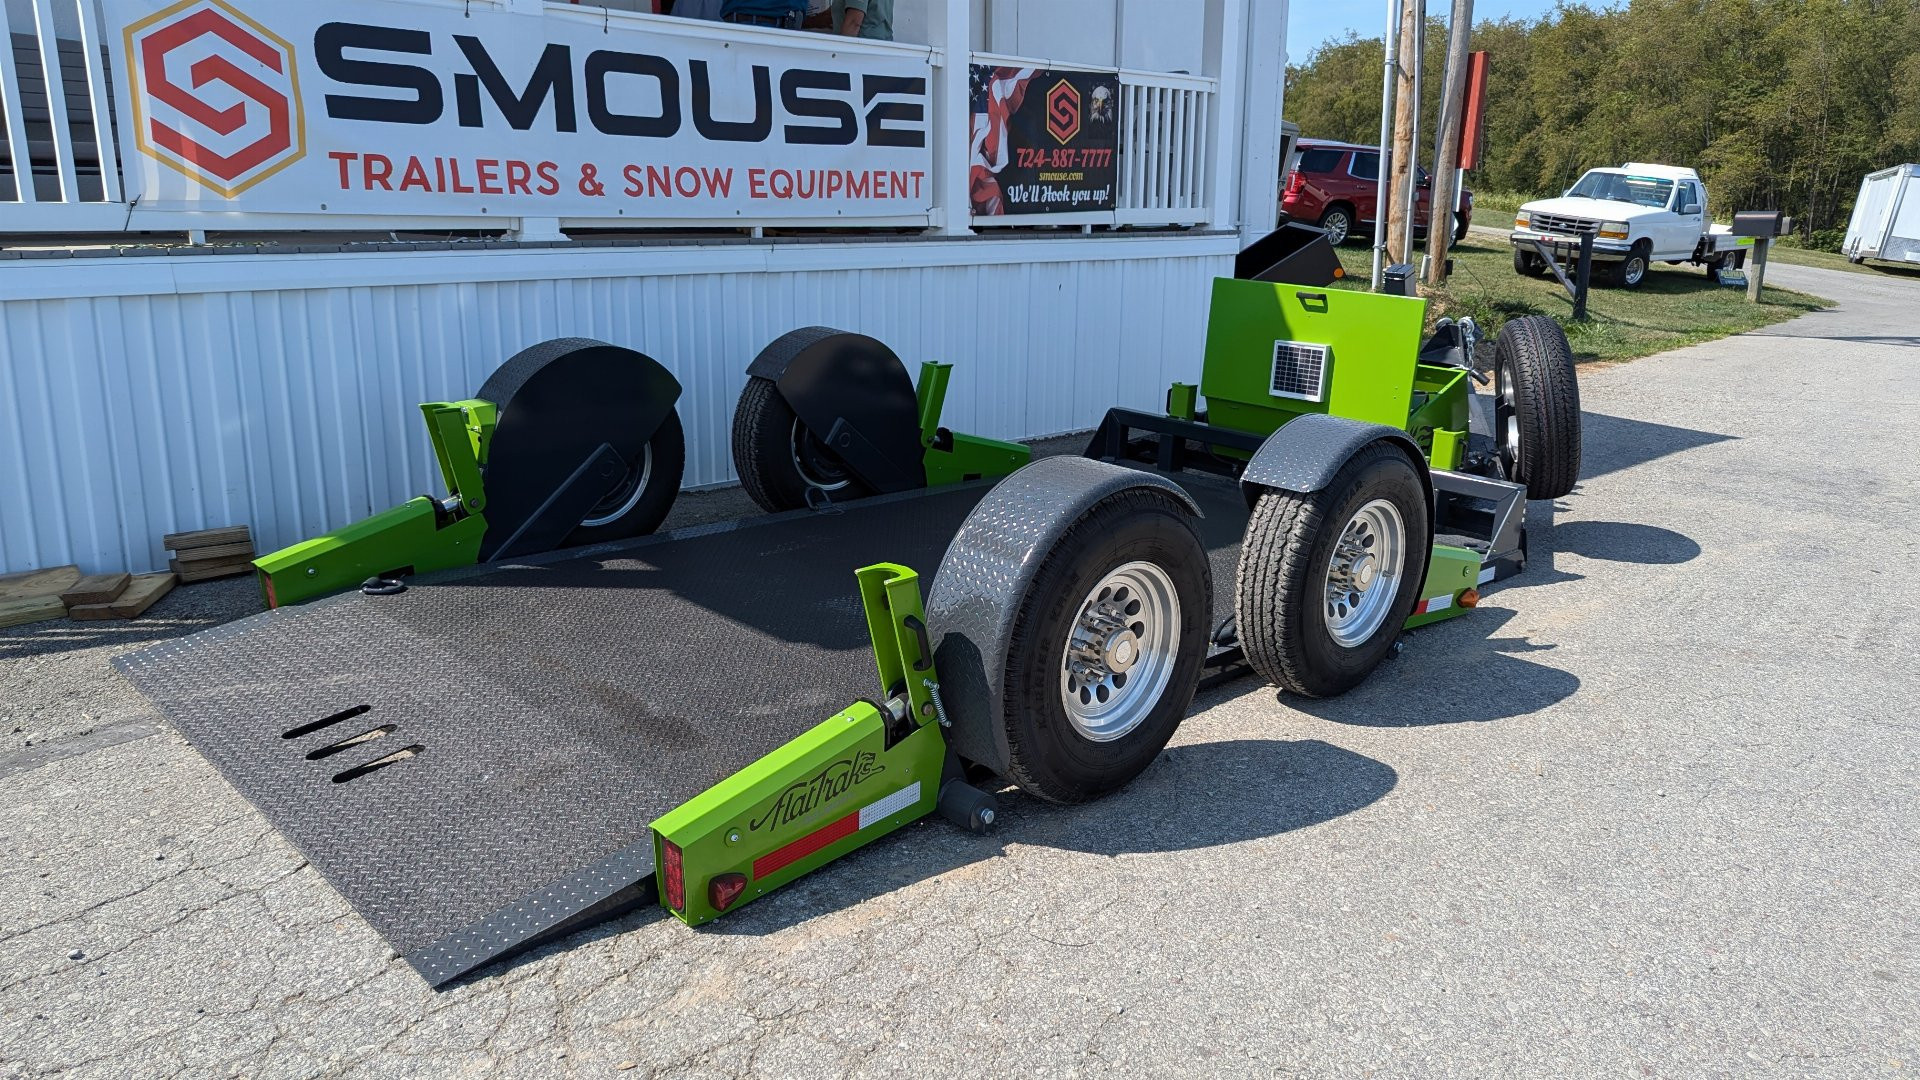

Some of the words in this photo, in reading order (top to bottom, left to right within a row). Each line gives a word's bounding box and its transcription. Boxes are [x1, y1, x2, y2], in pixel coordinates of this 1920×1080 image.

[314, 21, 926, 148] SMOUSE
[1017, 148, 1112, 169] 724-887-7777
[328, 151, 560, 196] TRAILERS
[578, 162, 606, 197] &
[623, 164, 733, 198] SNOW
[748, 168, 925, 200] EQUIPMENT
[1039, 172, 1083, 182] smouse.com
[1007, 184, 1040, 203] We'll
[1041, 184, 1070, 203] Hook
[1072, 190, 1091, 206] you
[1092, 184, 1111, 205] up!
